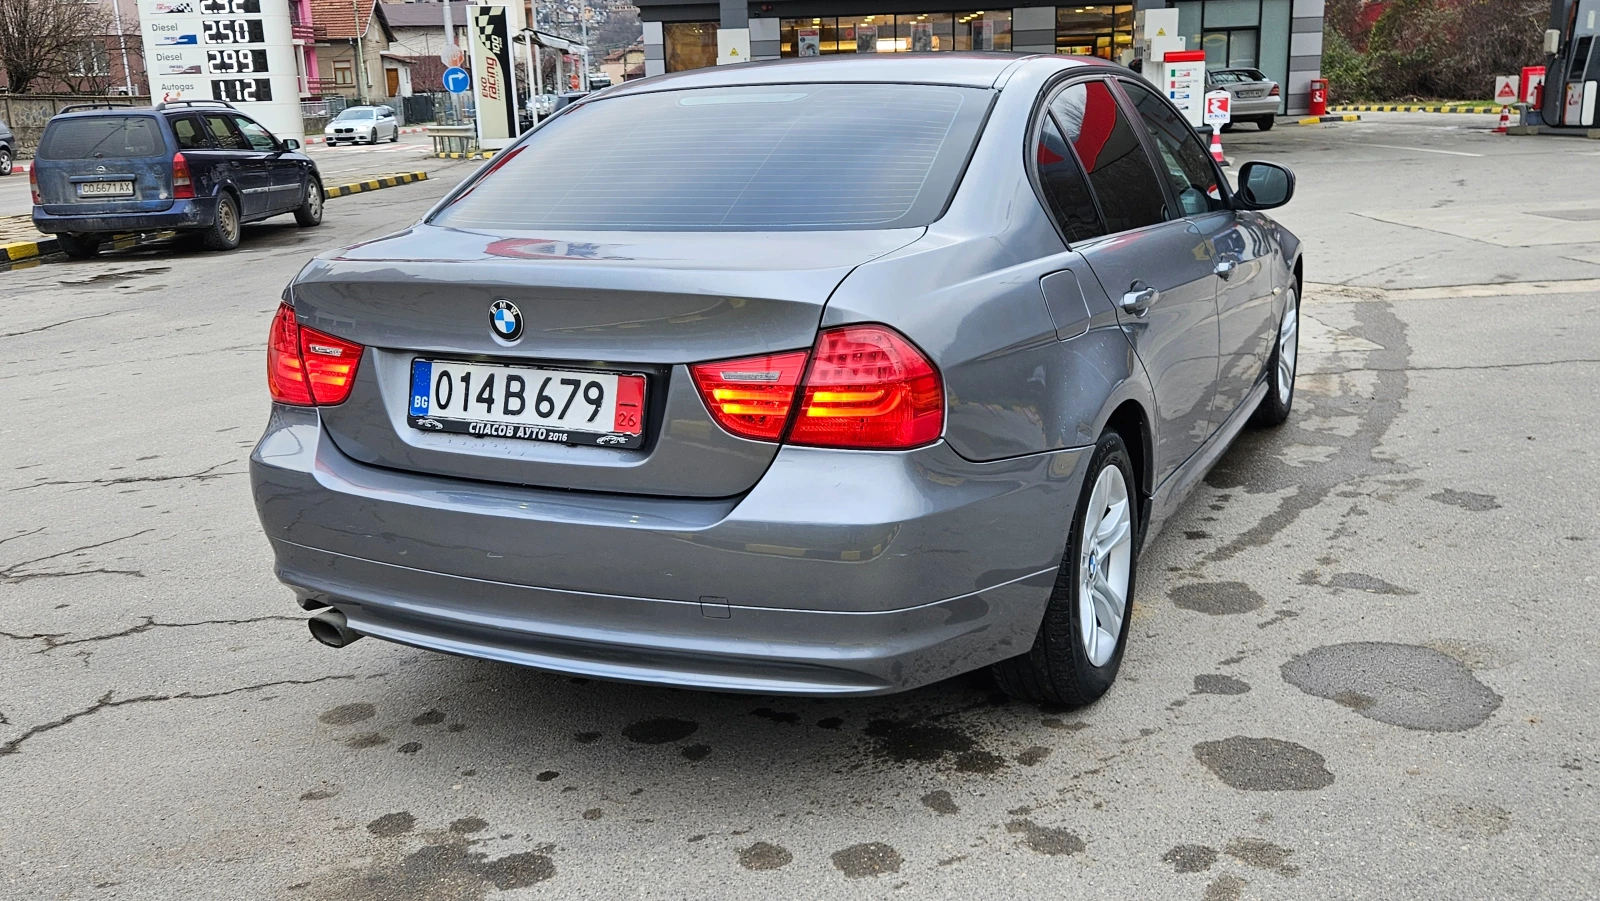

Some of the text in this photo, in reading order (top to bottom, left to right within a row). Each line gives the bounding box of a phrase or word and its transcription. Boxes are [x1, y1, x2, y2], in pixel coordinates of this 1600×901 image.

[151, 22, 178, 32] Diesel
[203, 20, 250, 44] 2.50
[491, 35, 501, 55] 100
[156, 53, 183, 61] Diesel
[208, 49, 254, 74] 2.99
[161, 83, 195, 92] Autogas
[481, 76, 489, 99] EKO
[486, 56, 498, 101] racing
[219, 79, 257, 102] 1.12
[489, 301, 519, 315] BMW
[414, 395, 428, 409] BG
[617, 412, 637, 427] 26
[469, 422, 568, 442] СПАСОВ АУТО 2016
